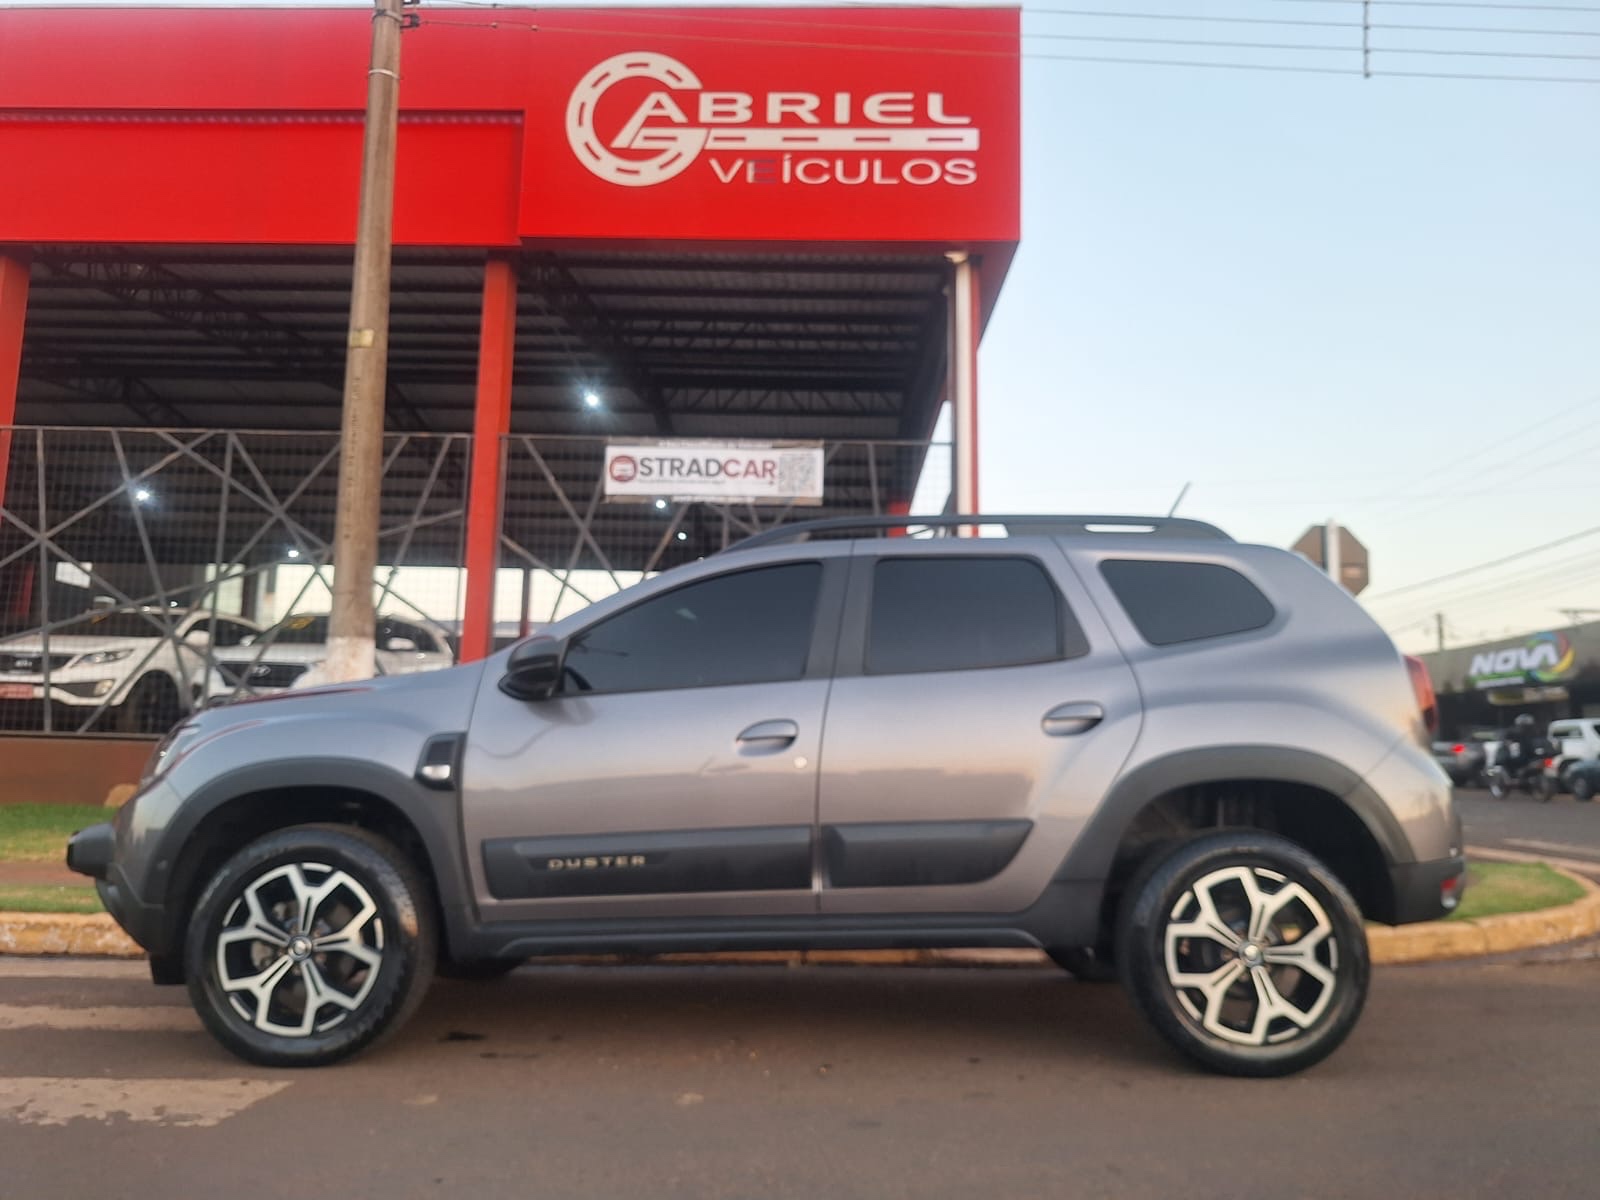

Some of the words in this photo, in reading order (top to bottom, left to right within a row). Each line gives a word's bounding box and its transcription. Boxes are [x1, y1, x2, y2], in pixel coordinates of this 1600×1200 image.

[639, 457, 776, 479] STRADCAR
[1469, 643, 1558, 675] NOVA
[548, 855, 646, 871] DUSTER
